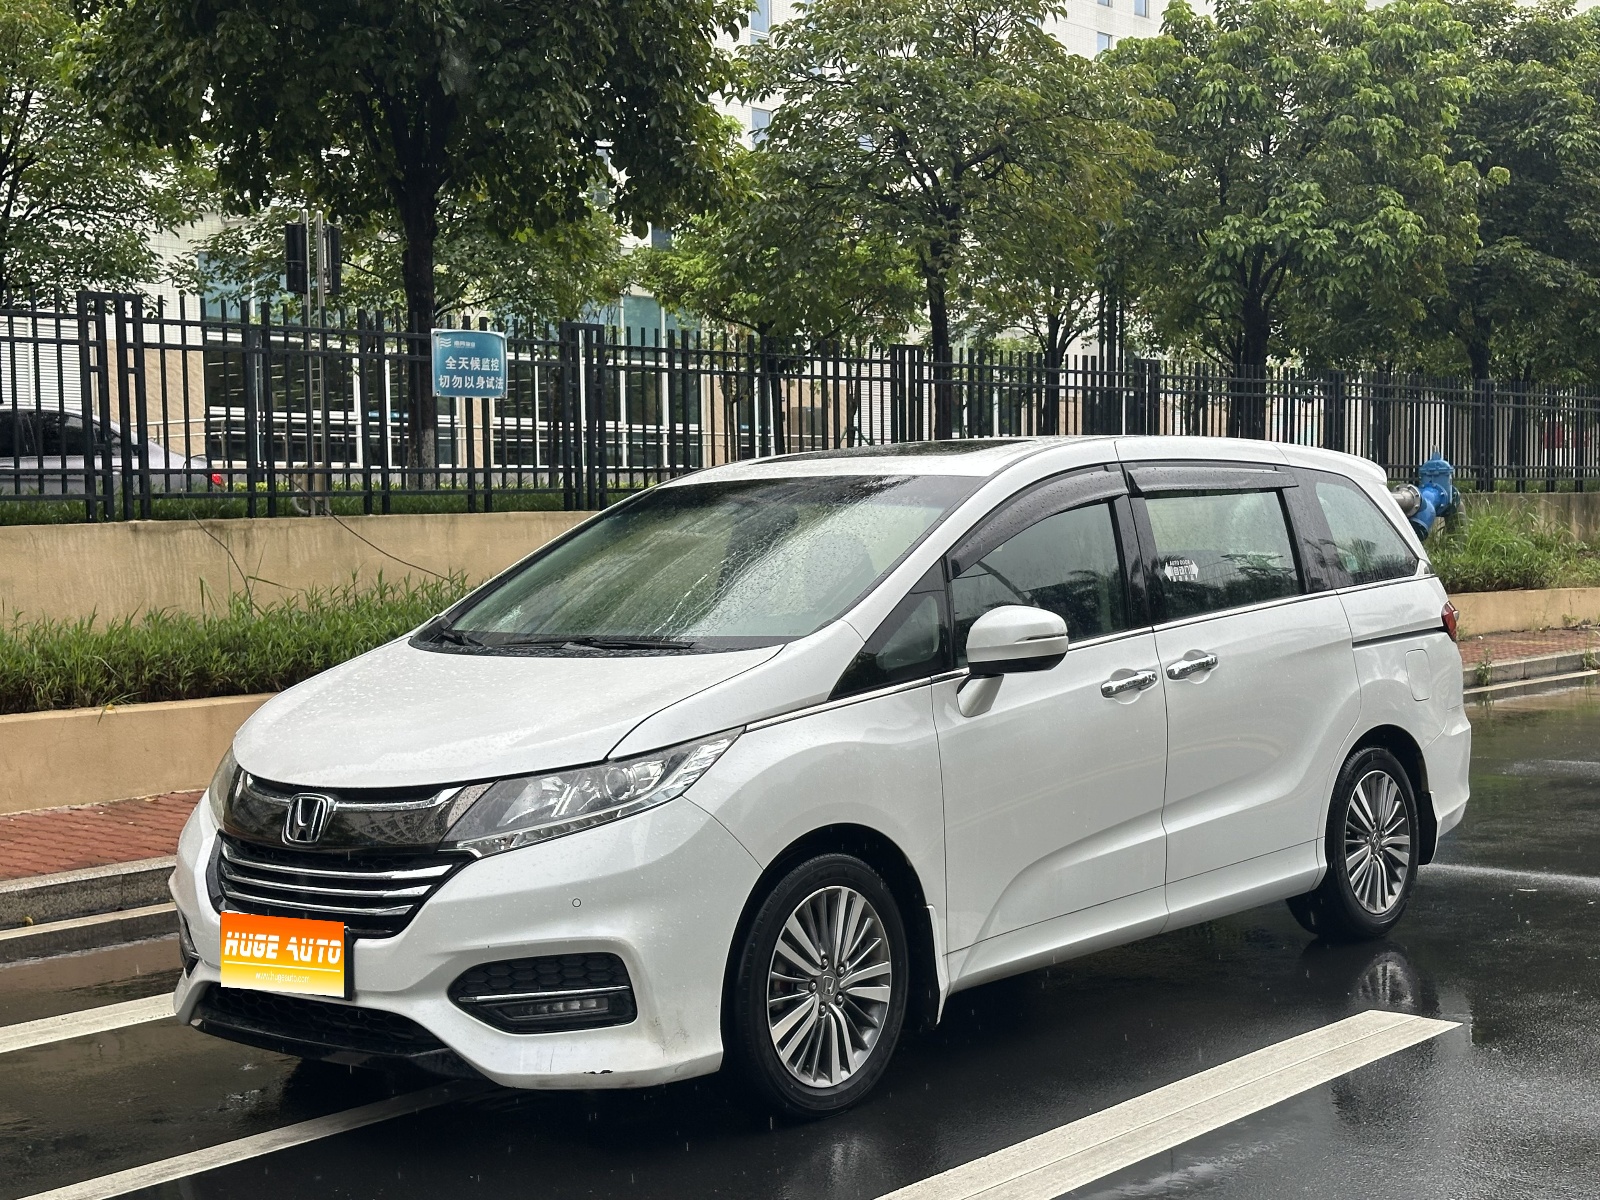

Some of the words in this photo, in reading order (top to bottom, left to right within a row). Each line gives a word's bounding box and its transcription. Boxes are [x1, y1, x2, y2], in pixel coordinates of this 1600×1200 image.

[445, 356, 499, 371] 全天候监控
[439, 375, 504, 390] 切勿以身试法
